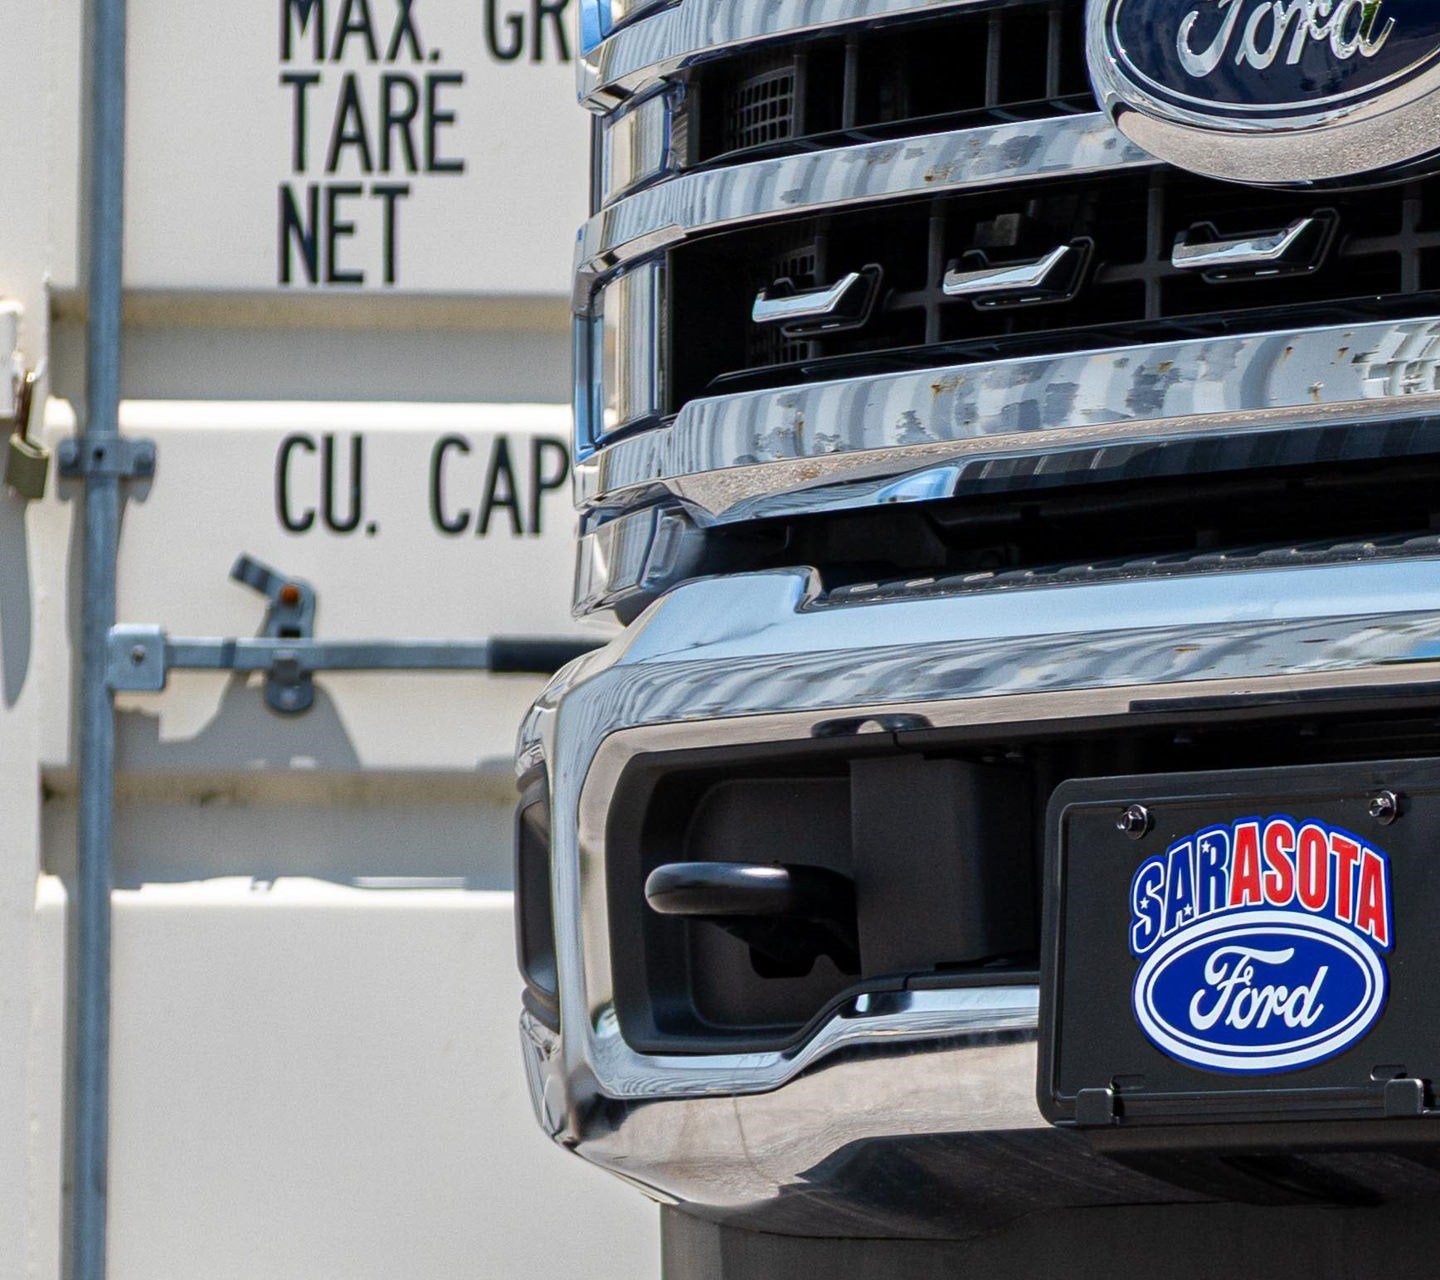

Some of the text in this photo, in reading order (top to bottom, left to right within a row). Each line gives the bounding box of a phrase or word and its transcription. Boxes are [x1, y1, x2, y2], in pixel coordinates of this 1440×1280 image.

[279, 70, 466, 175] TARE
[279, 181, 411, 286] NET
[274, 432, 570, 538] CU. CAP
[1131, 821, 1391, 954] SARASOTA
[1189, 945, 1329, 1030] Ford
